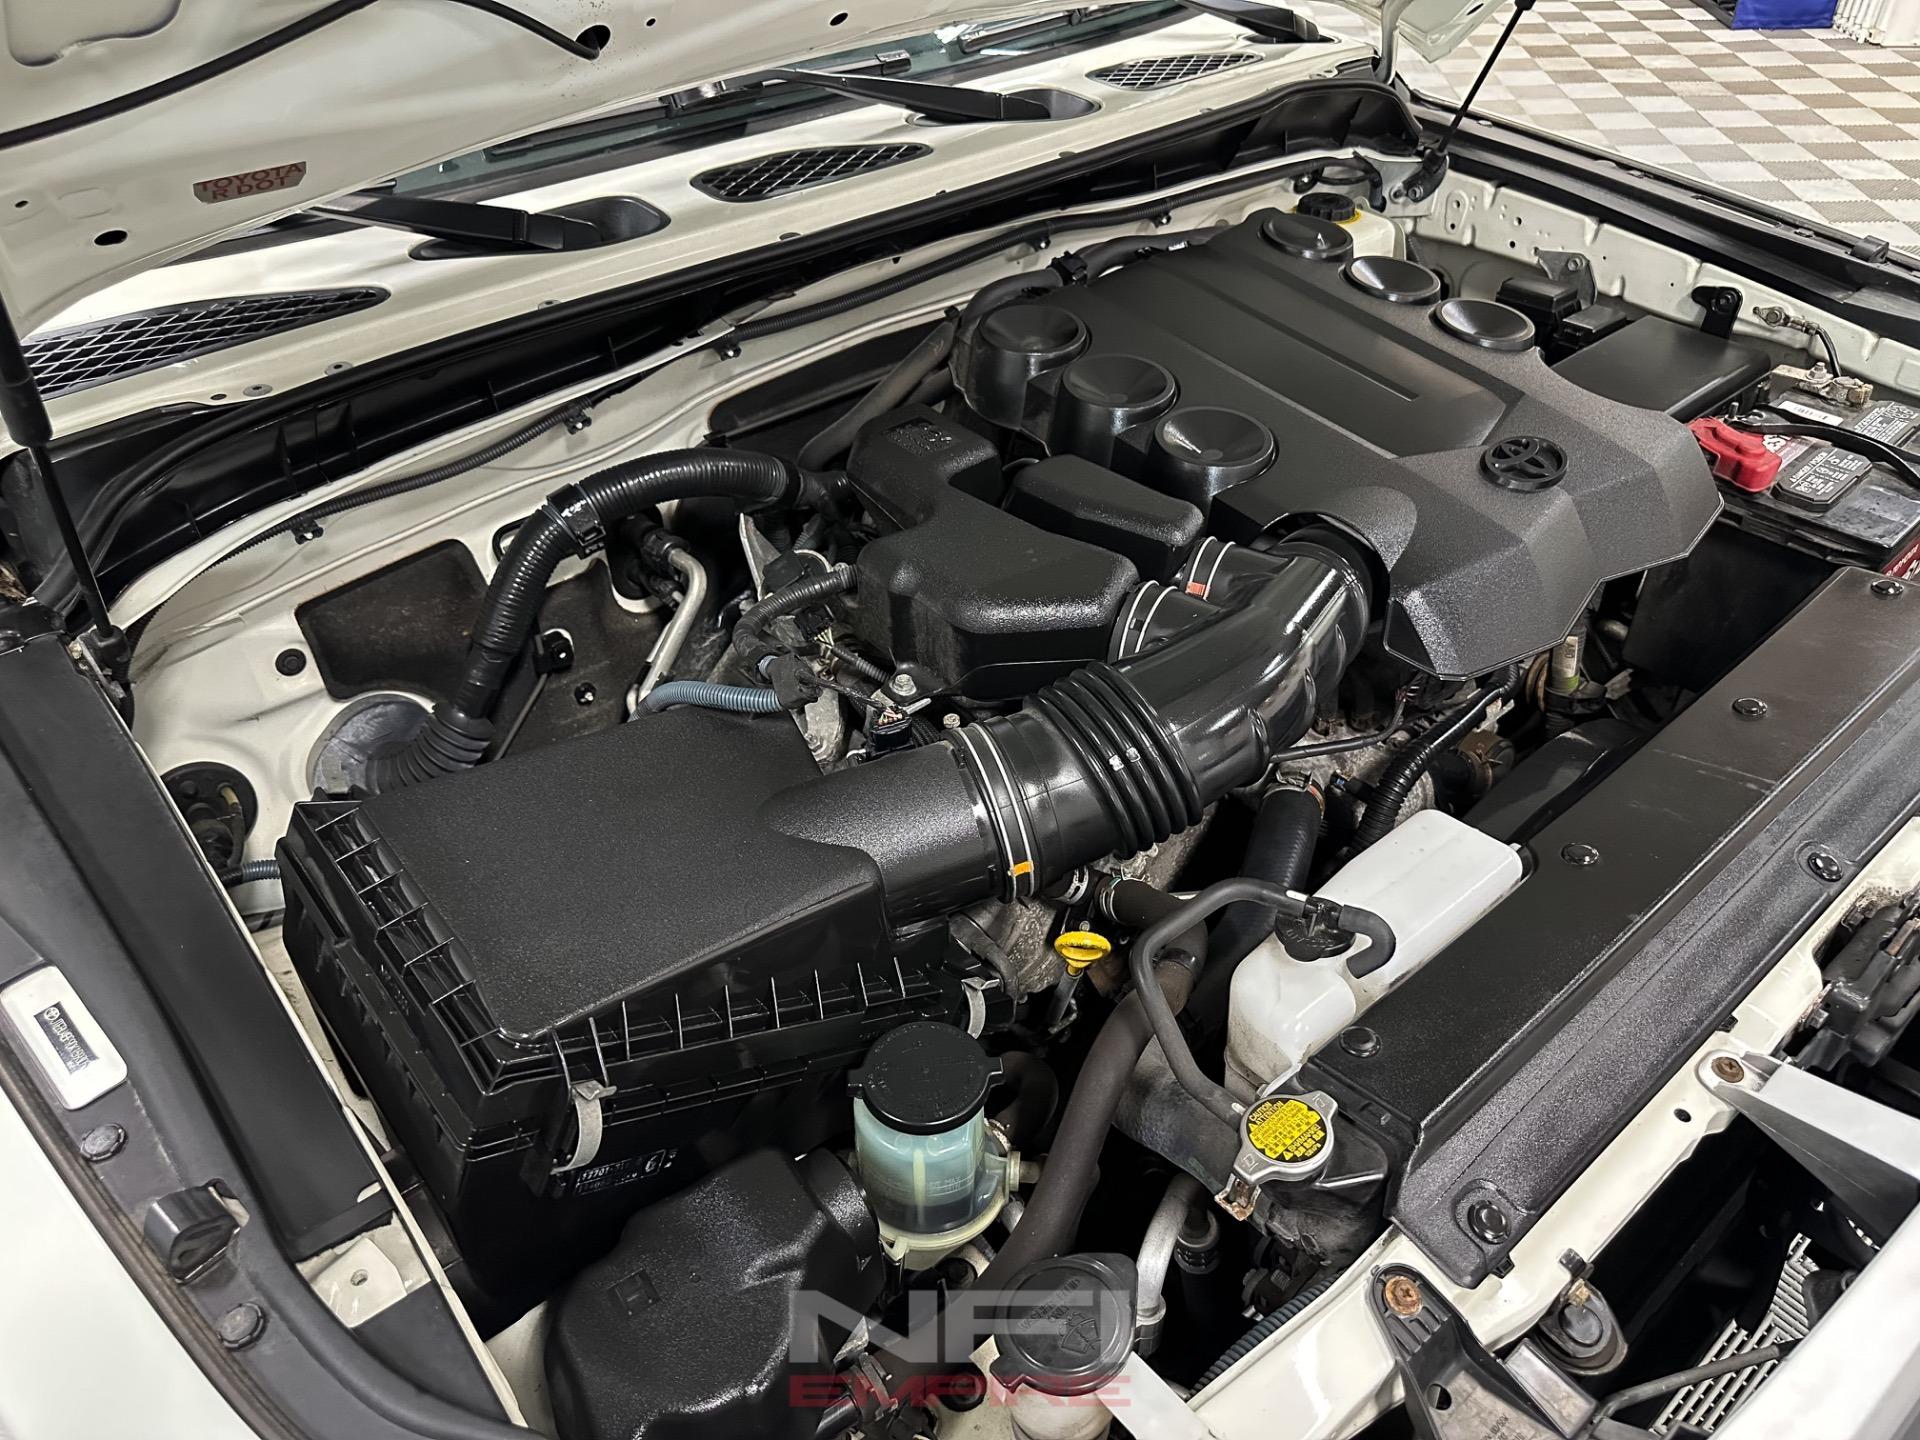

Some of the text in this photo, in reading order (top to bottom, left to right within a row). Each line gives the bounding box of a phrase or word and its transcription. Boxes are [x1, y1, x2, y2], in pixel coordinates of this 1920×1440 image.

[199, 163, 302, 192] TOYOTA
[237, 177, 287, 195] DOT
[1249, 1101, 1272, 1121] CAUTION
